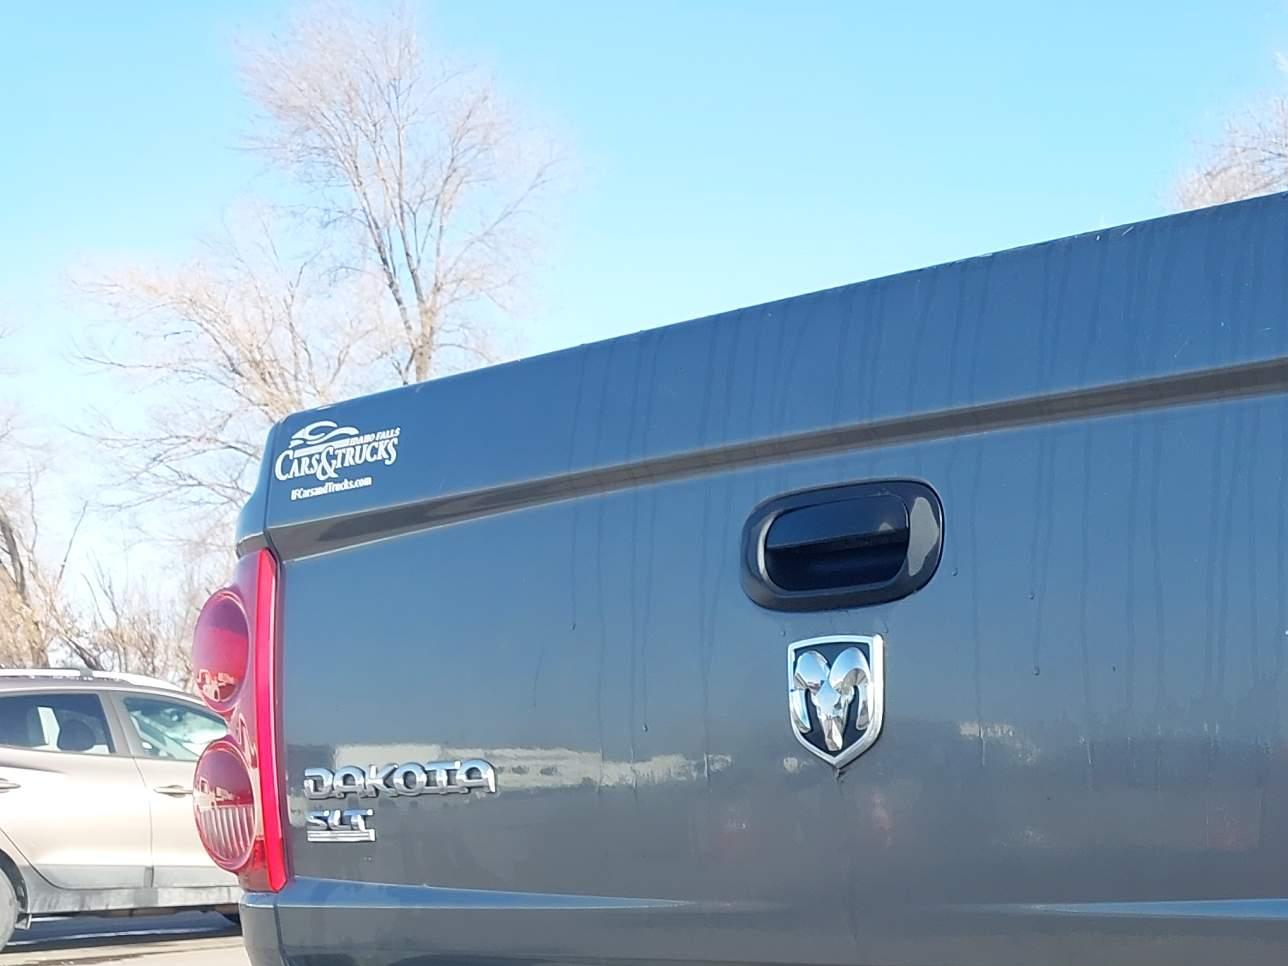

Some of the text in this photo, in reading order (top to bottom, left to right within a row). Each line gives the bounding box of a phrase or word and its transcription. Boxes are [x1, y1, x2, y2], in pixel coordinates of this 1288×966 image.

[375, 427, 400, 441] FALLS
[303, 759, 496, 800] DAKOTA
[307, 808, 374, 832] SLT
